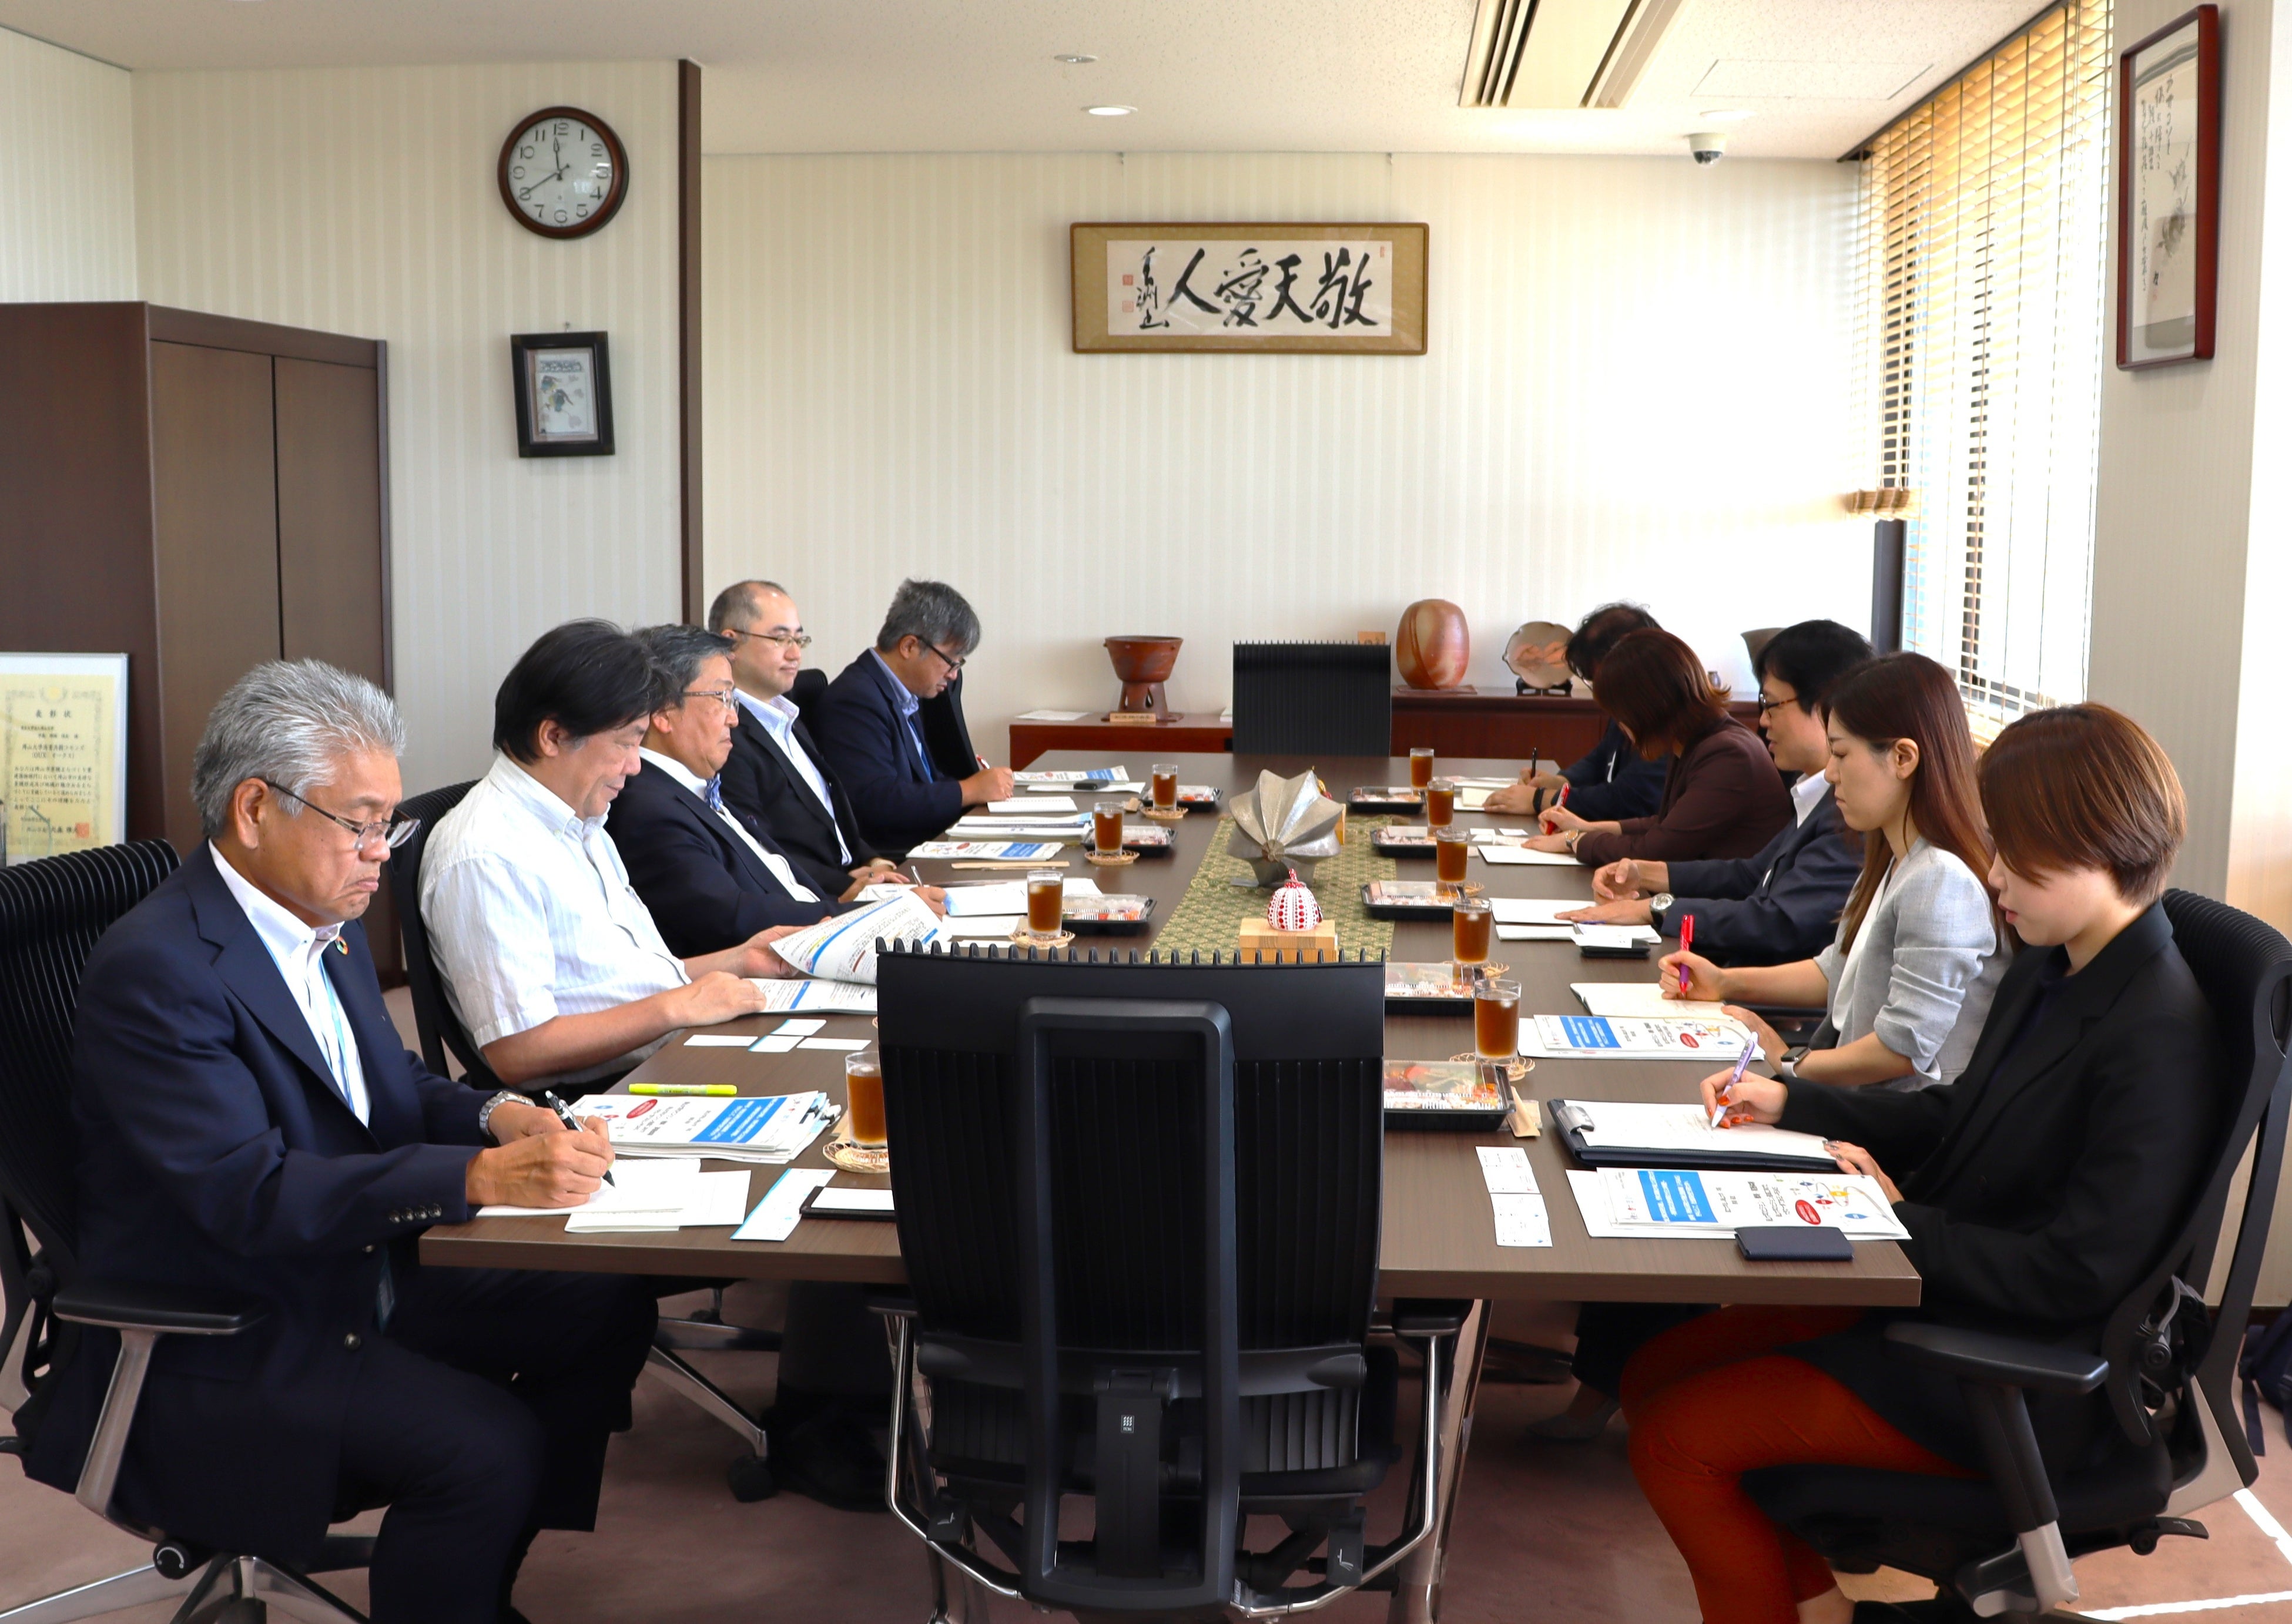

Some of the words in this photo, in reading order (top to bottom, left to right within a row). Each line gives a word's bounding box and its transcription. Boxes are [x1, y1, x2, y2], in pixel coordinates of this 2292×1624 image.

[554, 122, 569, 135] 12
[535, 129, 545, 142] 11
[520, 146, 535, 159] 10
[591, 143, 603, 157] 2
[512, 166, 525, 179] 9
[595, 166, 609, 179] 3
[519, 187, 531, 200] 8
[589, 186, 602, 200] 4
[534, 204, 545, 217] 7
[554, 209, 567, 223] 6
[576, 204, 588, 217] 5
[1164, 246, 1379, 329] 敬天愛人
